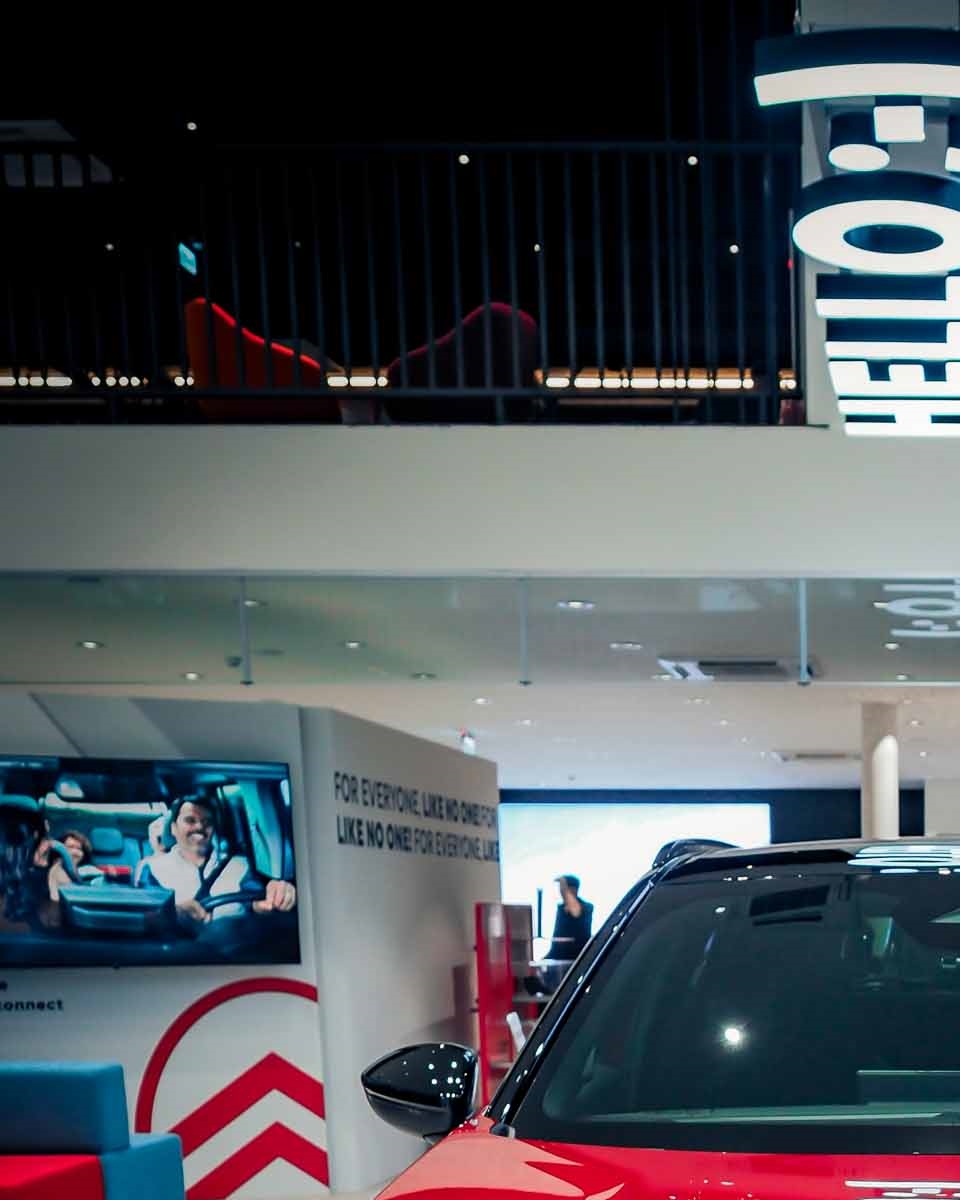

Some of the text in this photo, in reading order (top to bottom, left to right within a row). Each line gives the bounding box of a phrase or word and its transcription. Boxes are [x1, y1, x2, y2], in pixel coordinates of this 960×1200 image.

[333, 770, 359, 804] FOR
[422, 791, 443, 820] LIKE
[446, 797, 459, 823] NO
[337, 813, 364, 847] LIKE
[366, 820, 385, 849] NO
[0, 999, 64, 1012] onnect
